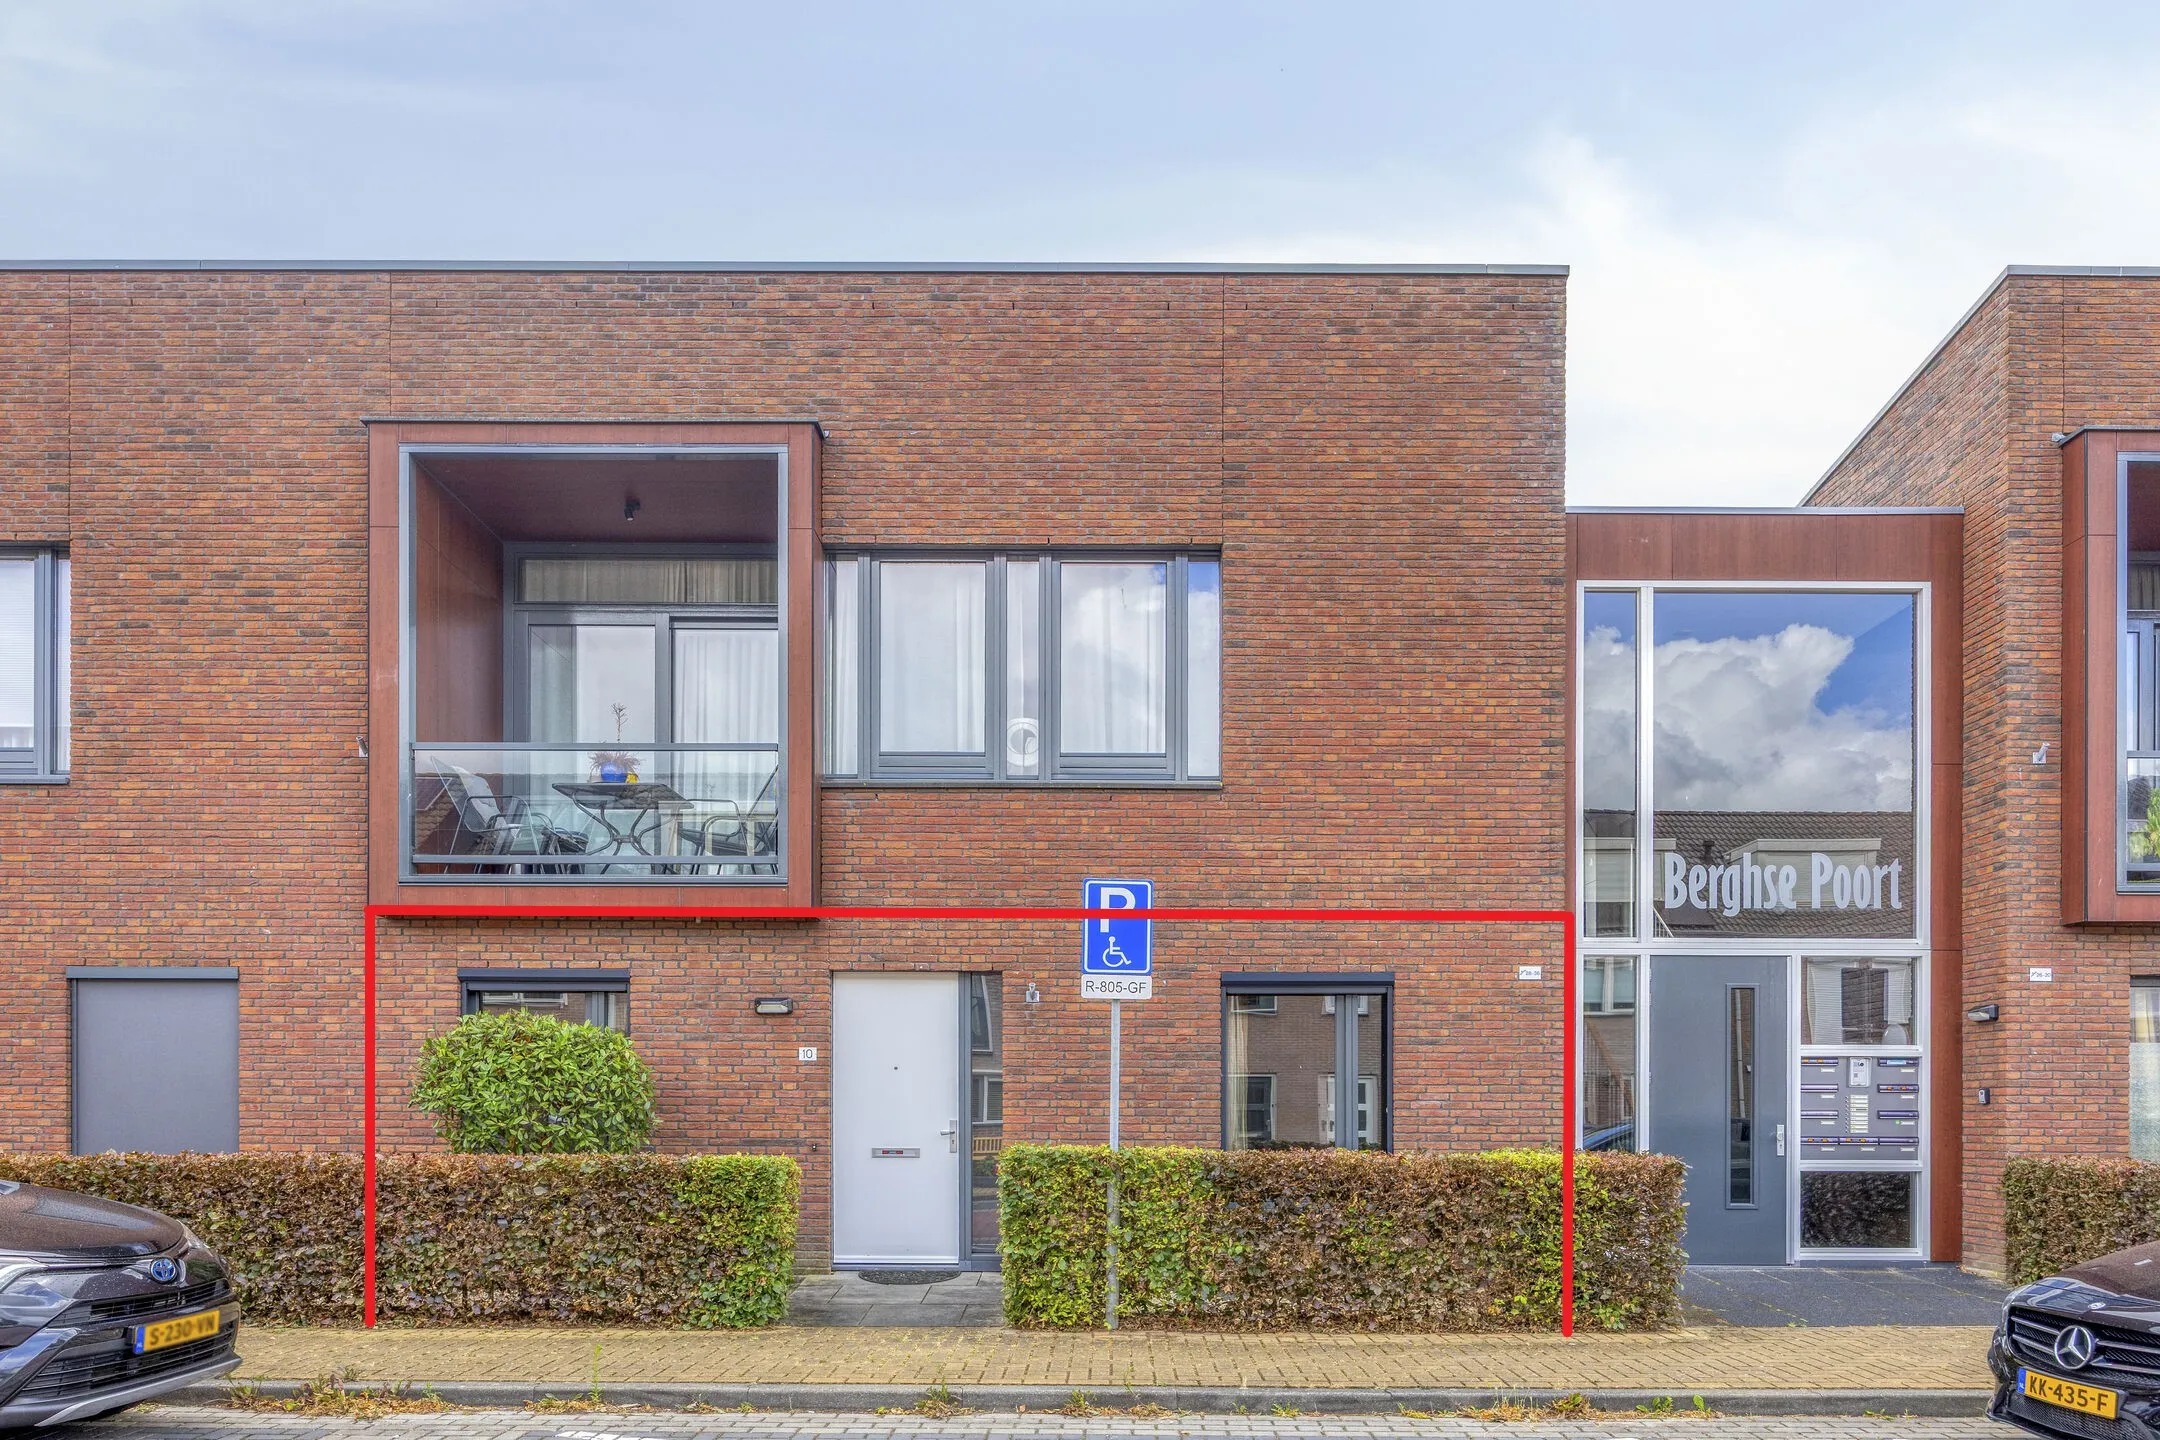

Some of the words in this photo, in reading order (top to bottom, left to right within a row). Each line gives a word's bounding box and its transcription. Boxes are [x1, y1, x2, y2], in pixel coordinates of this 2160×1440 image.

[1664, 852, 1797, 917] Berghse
[1811, 852, 1902, 909] Poort
[1100, 886, 1136, 933] P
[1085, 980, 1147, 994] R-805-GF
[802, 1048, 813, 1059] 10
[2029, 1375, 2109, 1411] KK-435-F
